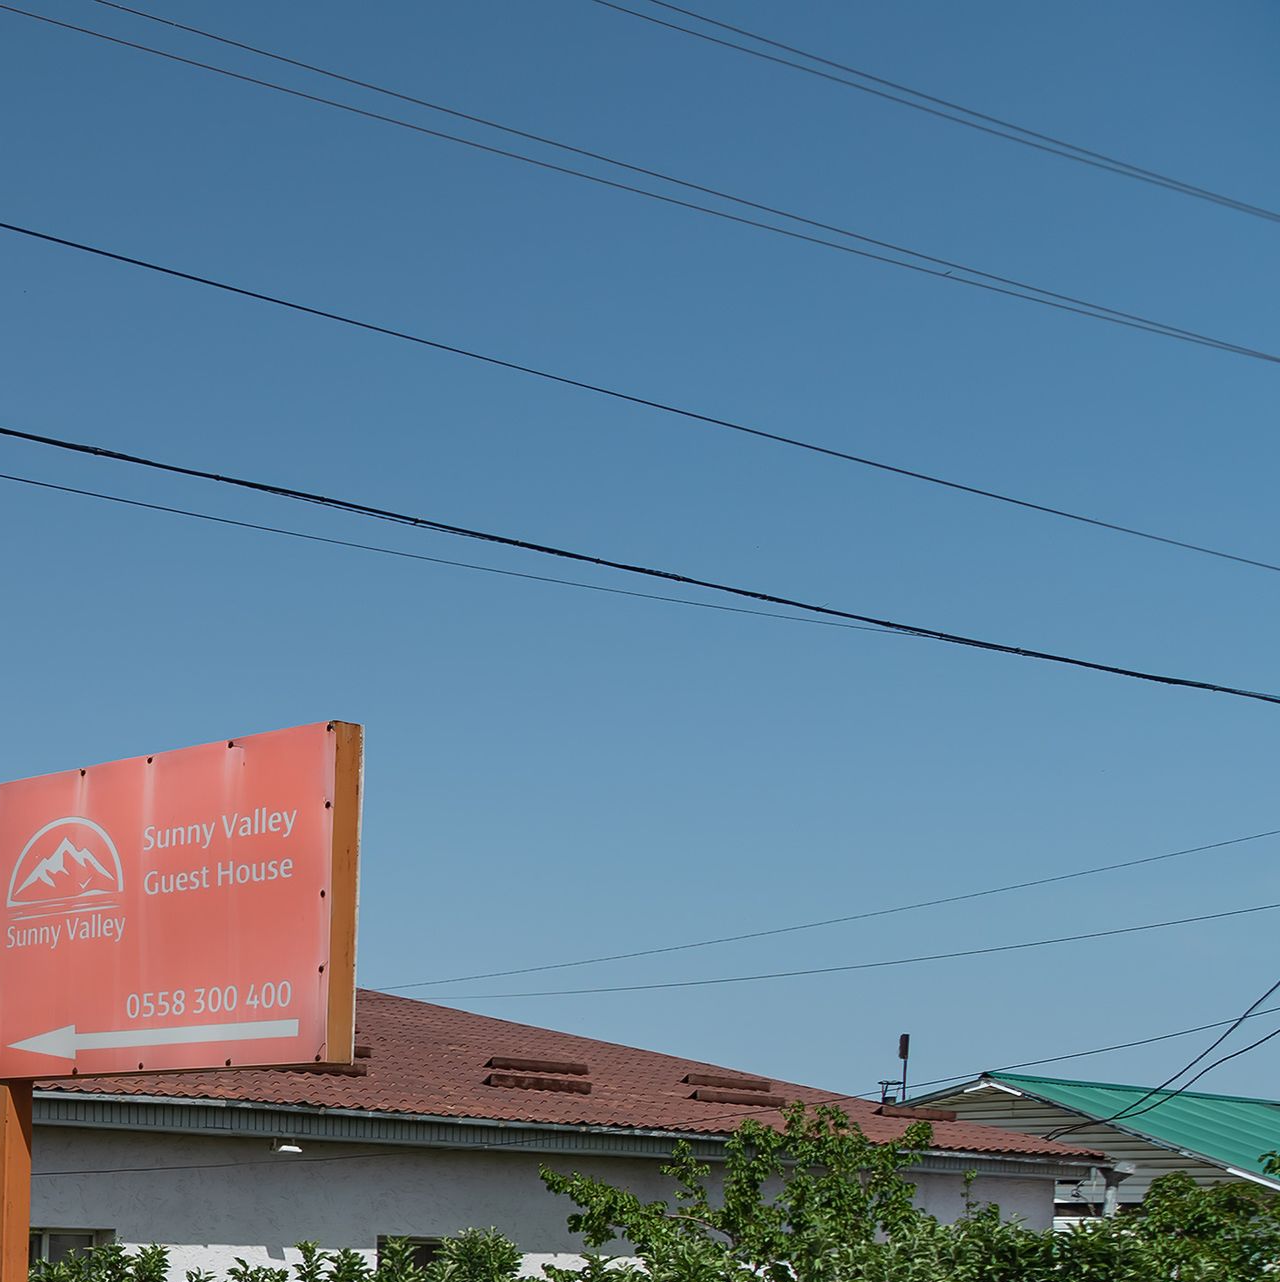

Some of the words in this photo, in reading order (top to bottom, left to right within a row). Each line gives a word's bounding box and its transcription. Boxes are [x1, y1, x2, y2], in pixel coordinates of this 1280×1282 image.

[143, 822, 215, 851] Sunny
[222, 807, 297, 838] Valley
[144, 866, 209, 896] Guest
[217, 858, 293, 886] House
[6, 922, 61, 949] Sunny
[66, 914, 126, 942] Valley
[127, 989, 186, 1019] 0558
[193, 986, 238, 1014] 300
[246, 980, 292, 1009] 400
